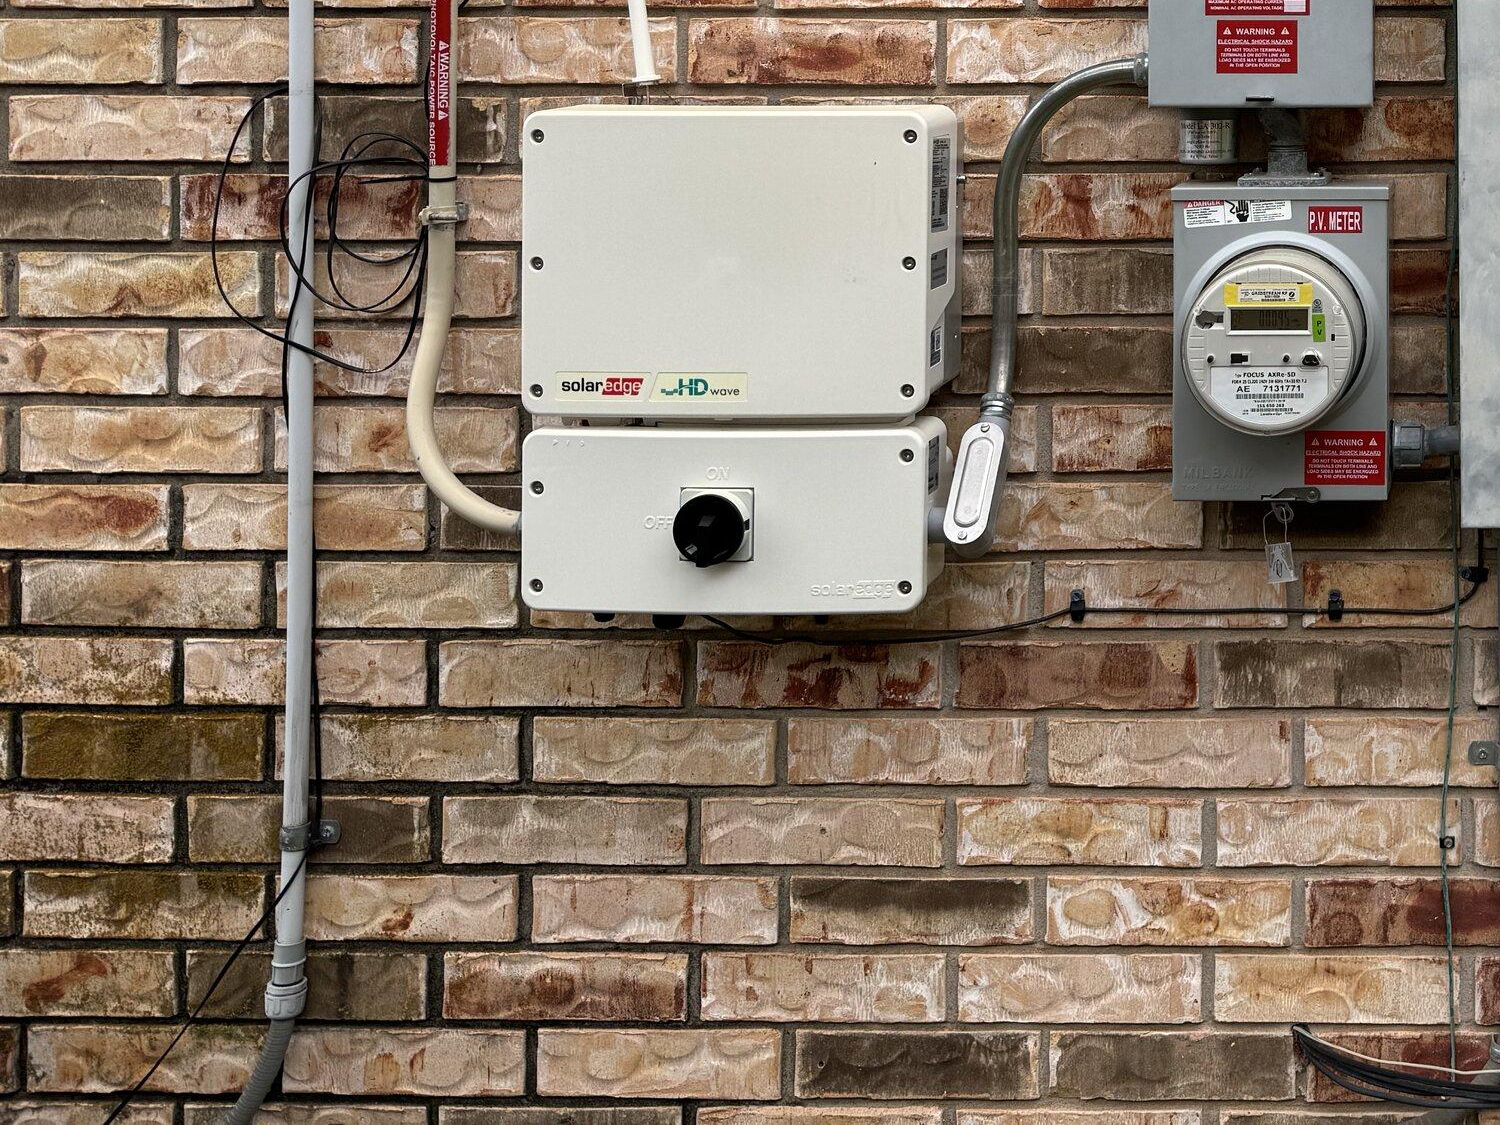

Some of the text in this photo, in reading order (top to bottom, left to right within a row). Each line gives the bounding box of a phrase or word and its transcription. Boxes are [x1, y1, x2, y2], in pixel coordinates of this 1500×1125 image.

[438, 52, 449, 108] WARNING
[428, 122, 436, 166] SOURCE
[1309, 211, 1327, 231] P.V.
[1328, 211, 1361, 231] METER
[561, 377, 740, 396] solaredge HD wave
[705, 467, 730, 480] ON
[643, 515, 673, 529] OFF
[811, 580, 895, 598] solaredge
